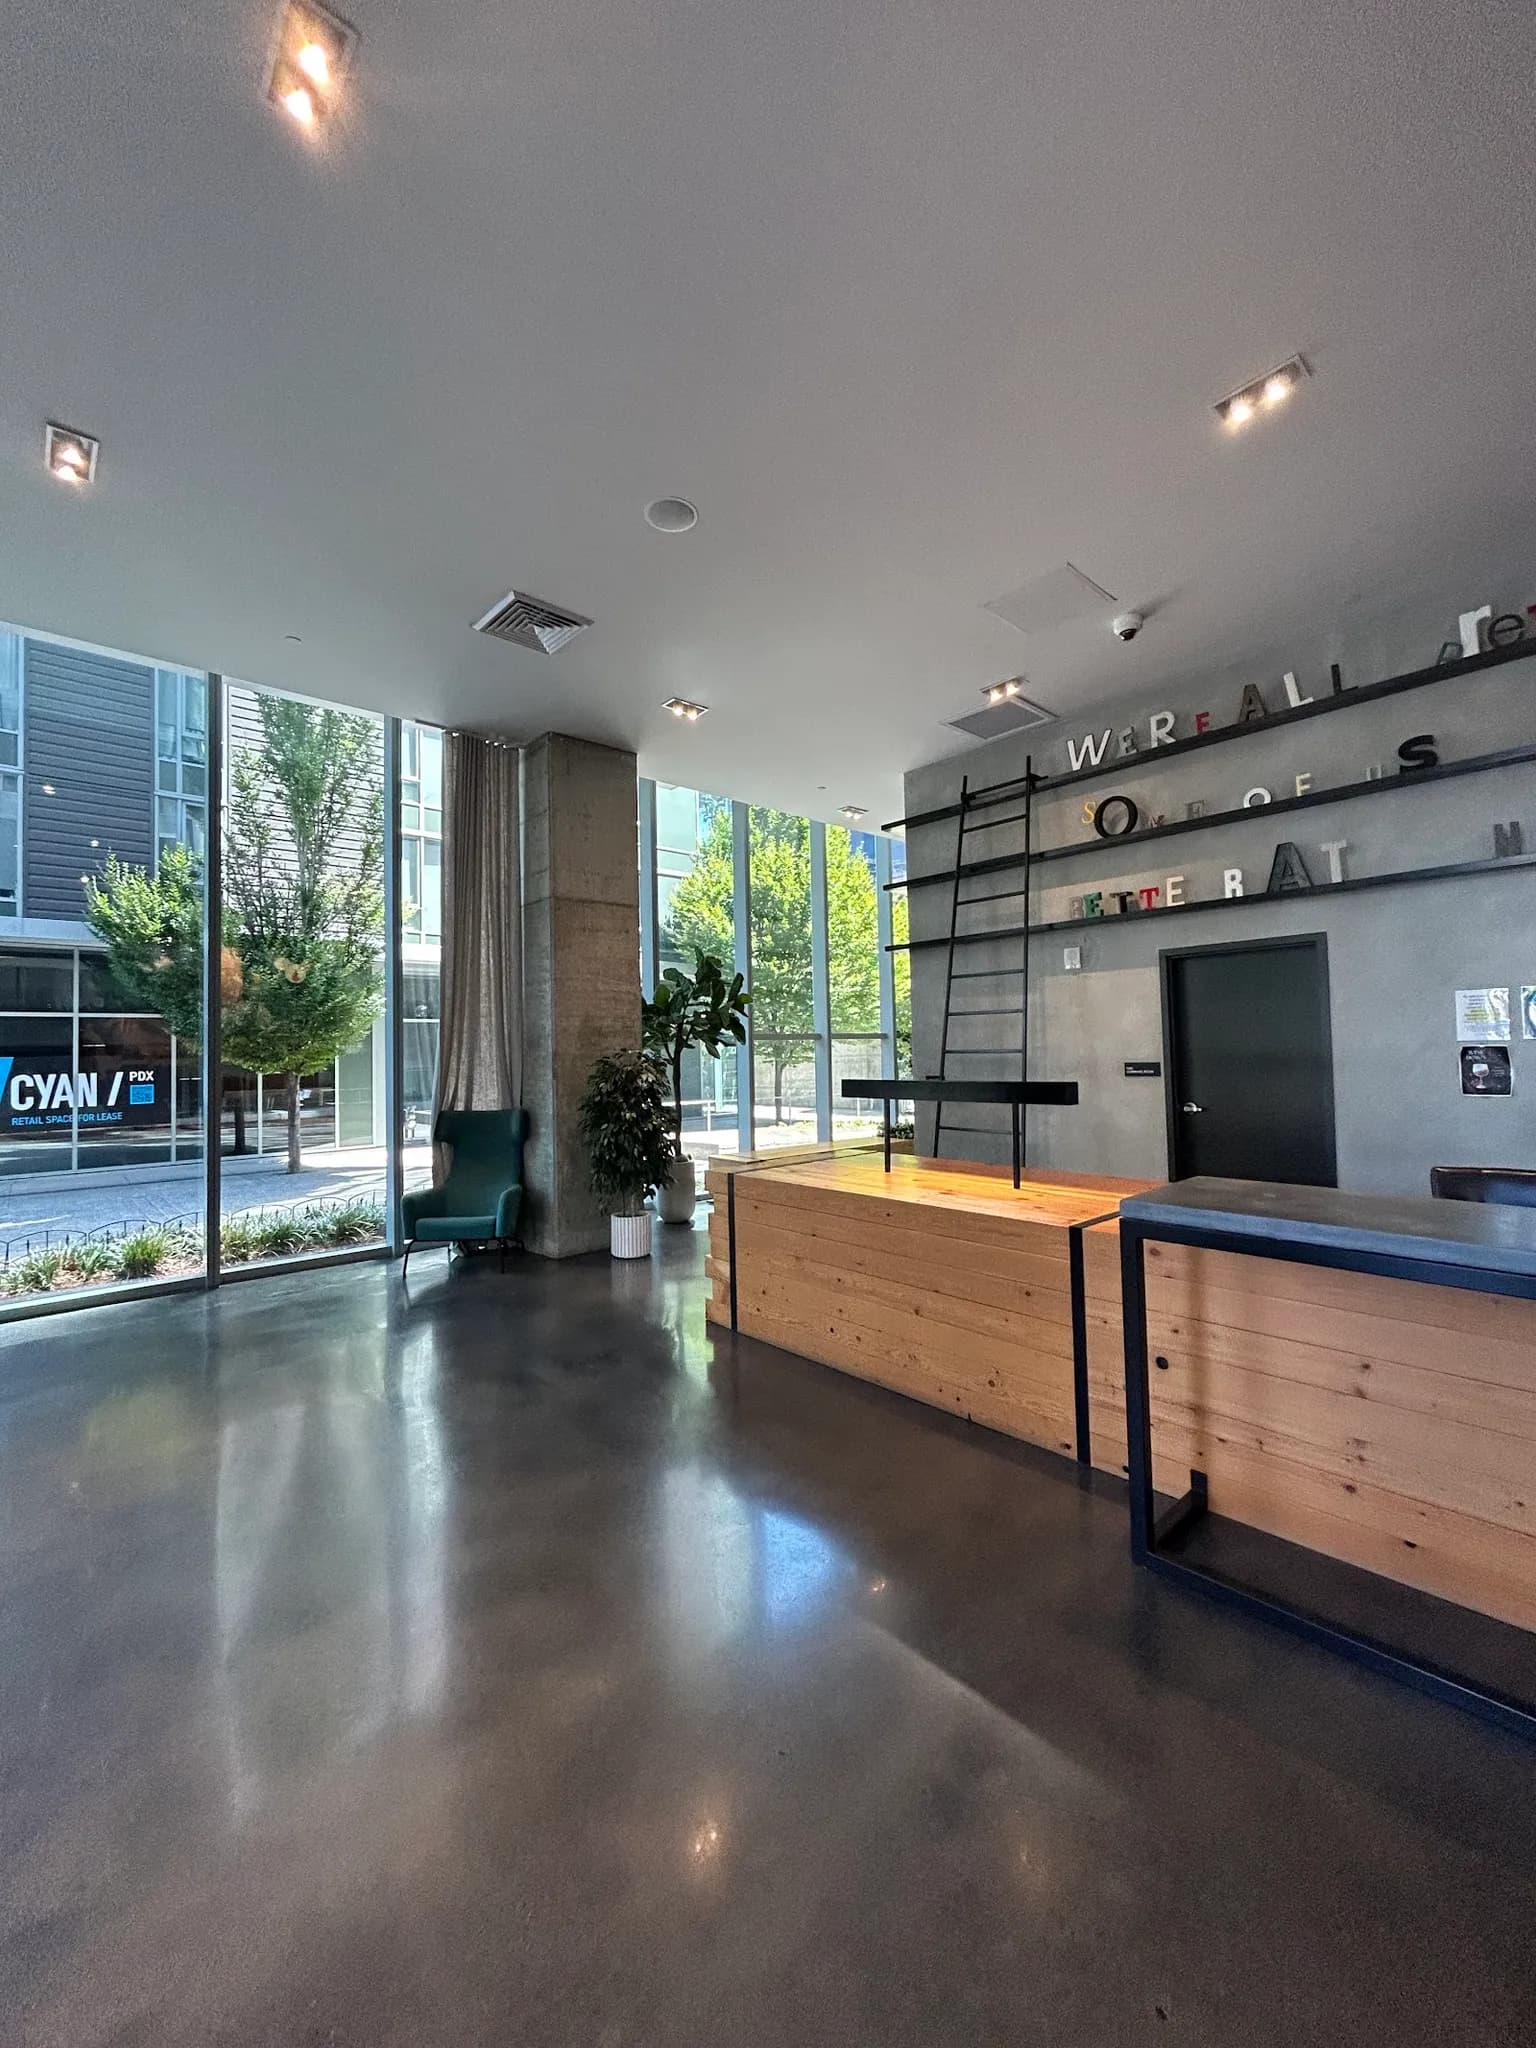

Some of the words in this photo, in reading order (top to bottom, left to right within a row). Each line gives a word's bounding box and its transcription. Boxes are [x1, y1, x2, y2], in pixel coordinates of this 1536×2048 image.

[1239, 663, 1358, 722] ALL
[1265, 840, 1347, 893] AT
[10, 1071, 98, 1111] CYAN
[129, 1070, 154, 1082] PDX
[11, 1115, 44, 1127] RETAIL
[78, 1113, 95, 1122] FOR
[97, 1111, 123, 1121] LEASE
